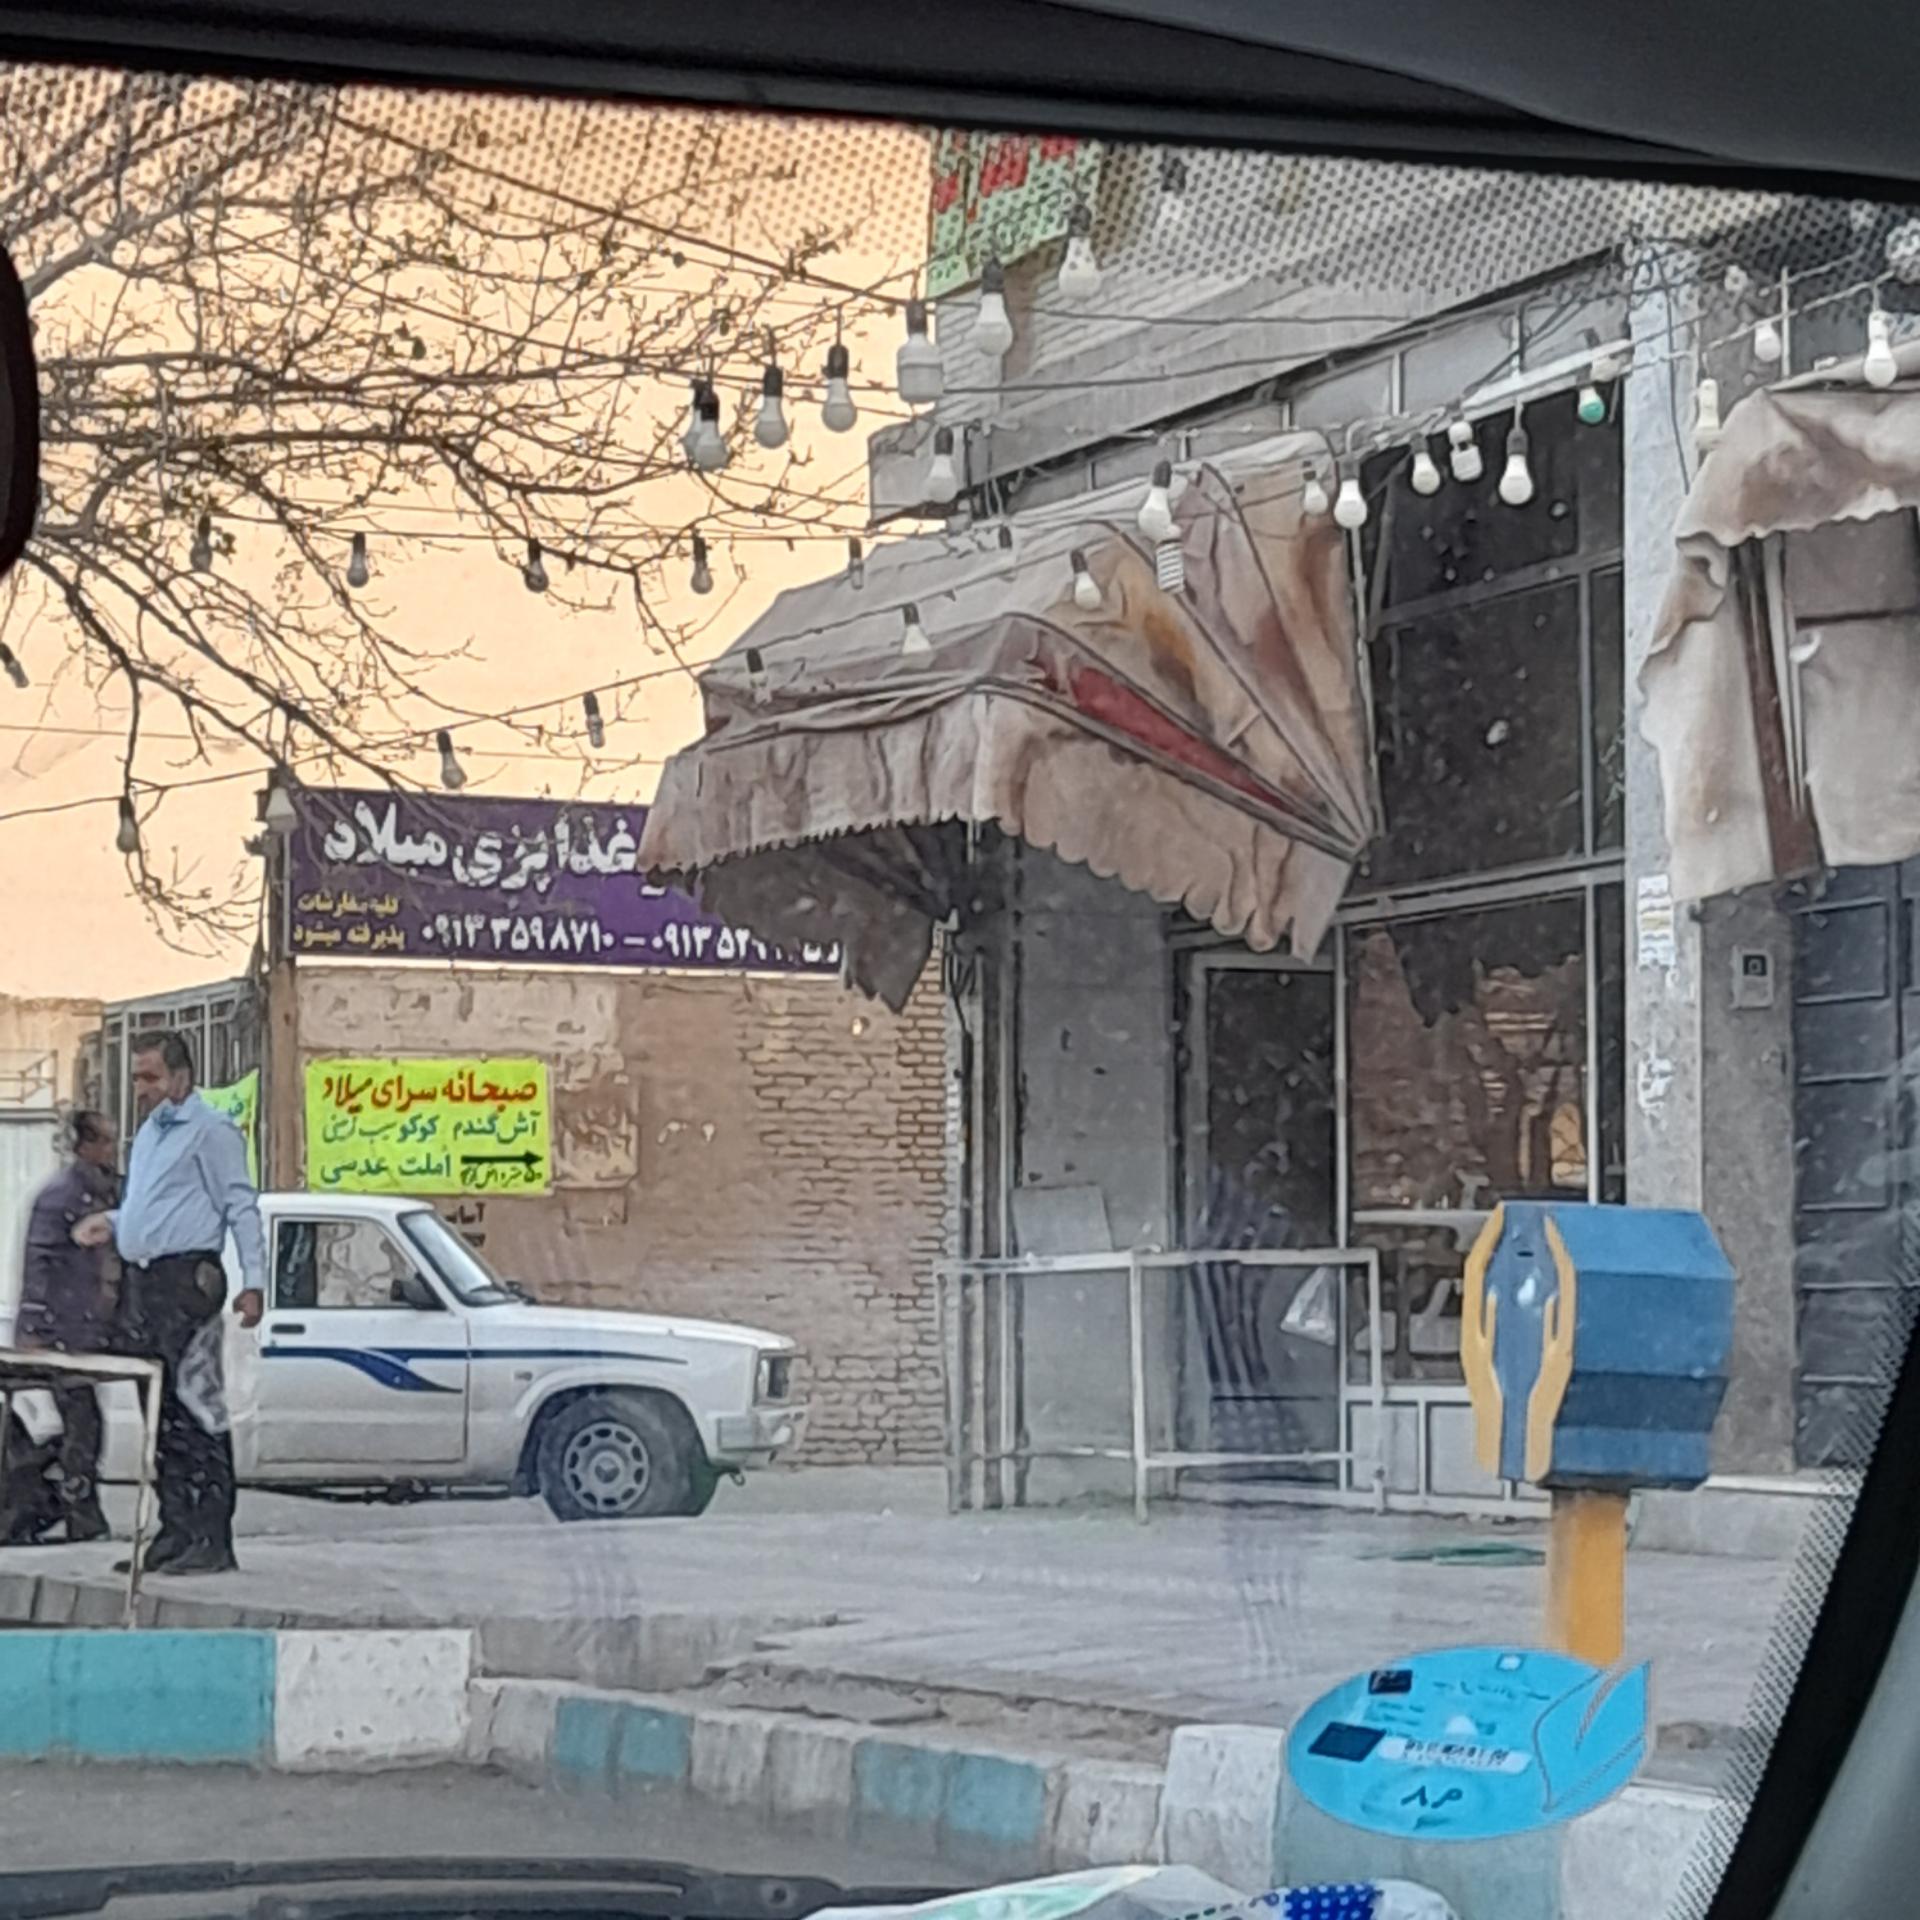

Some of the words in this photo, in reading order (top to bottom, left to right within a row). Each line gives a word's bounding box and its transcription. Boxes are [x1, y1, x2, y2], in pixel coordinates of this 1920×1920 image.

[324, 800, 447, 877] میلاد
[322, 1073, 374, 1113] میلاد
[372, 1075, 437, 1111] سرای
[442, 1070, 538, 1111] صبحانه
[397, 1112, 441, 1142] کوکو
[453, 1113, 499, 1141] گندم
[496, 1111, 541, 1144] آش
[320, 1158, 389, 1183] عدسی
